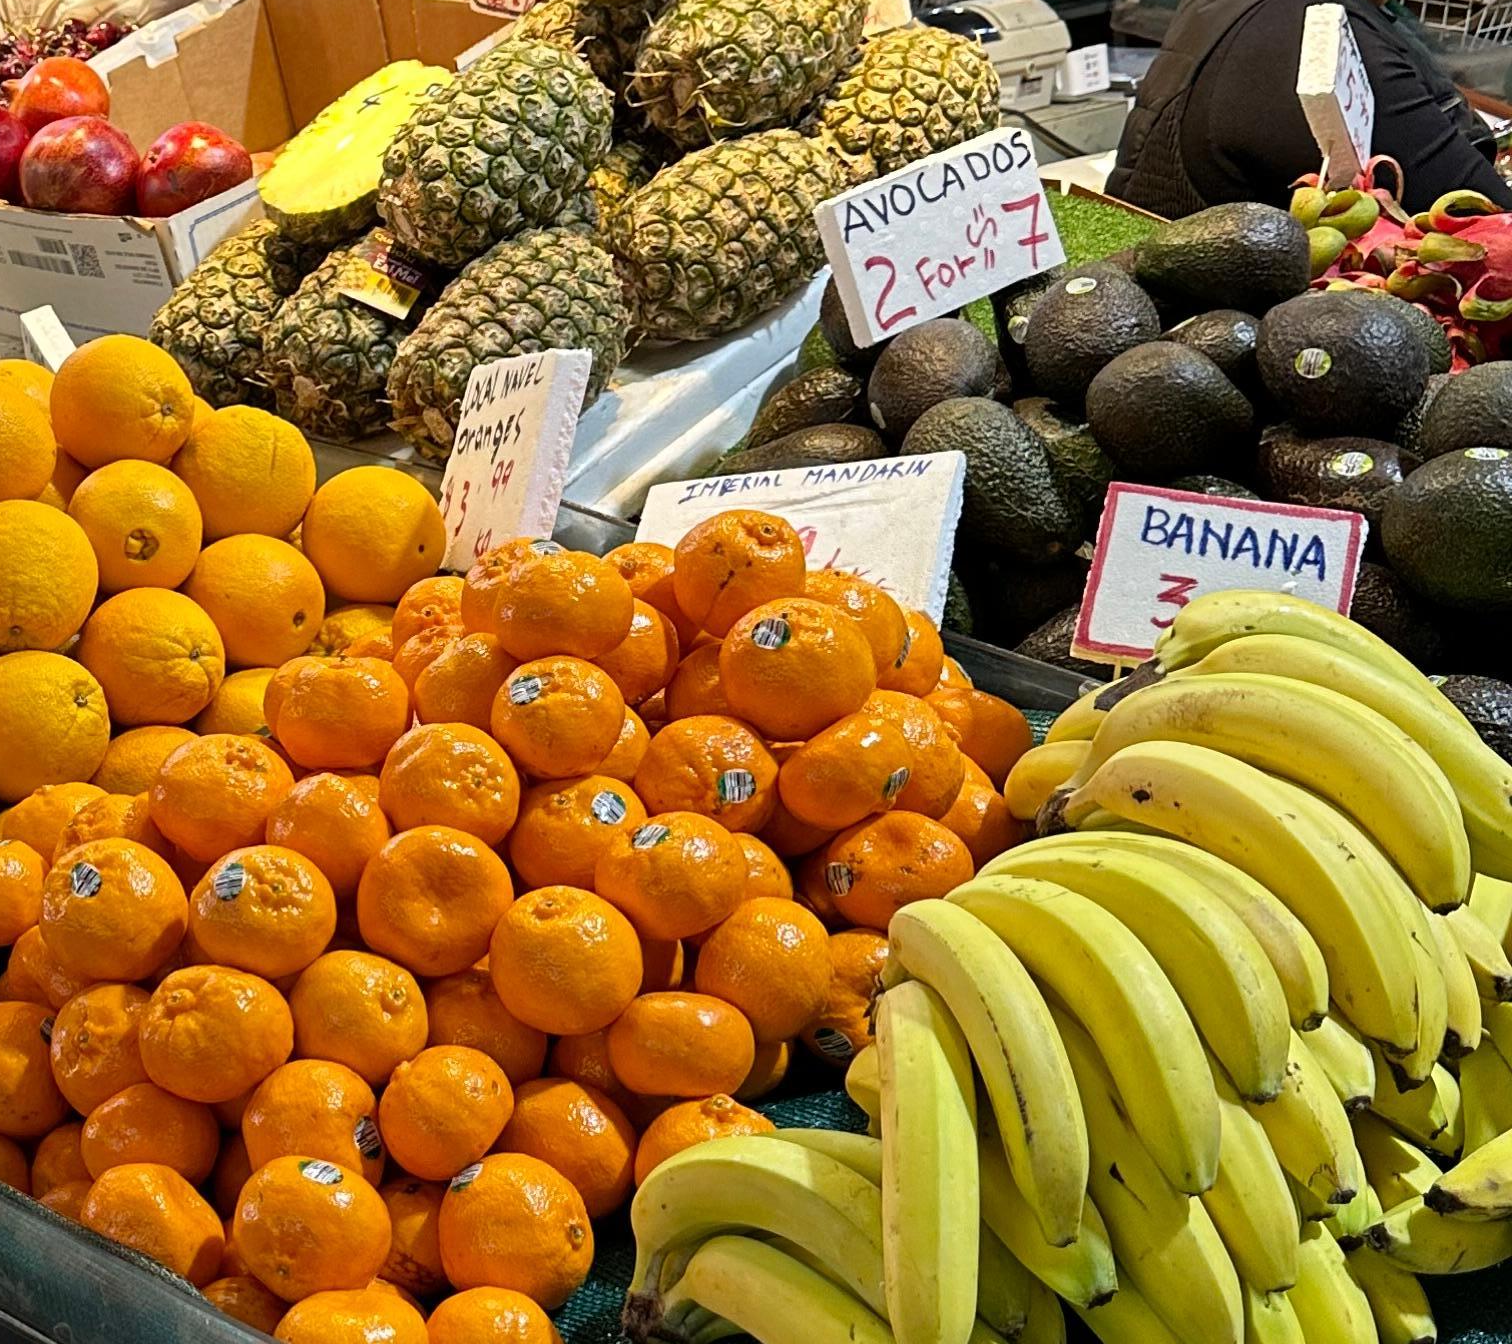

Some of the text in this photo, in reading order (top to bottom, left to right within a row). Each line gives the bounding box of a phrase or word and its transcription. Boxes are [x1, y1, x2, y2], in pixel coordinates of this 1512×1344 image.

[844, 131, 1032, 244] AVOCADOS
[864, 255, 918, 332] 2
[463, 355, 546, 420] LOCAL NAVEL
[801, 459, 934, 487] MANDARIN
[1141, 505, 1326, 582] BANANA
[1150, 572, 1199, 629] 3
